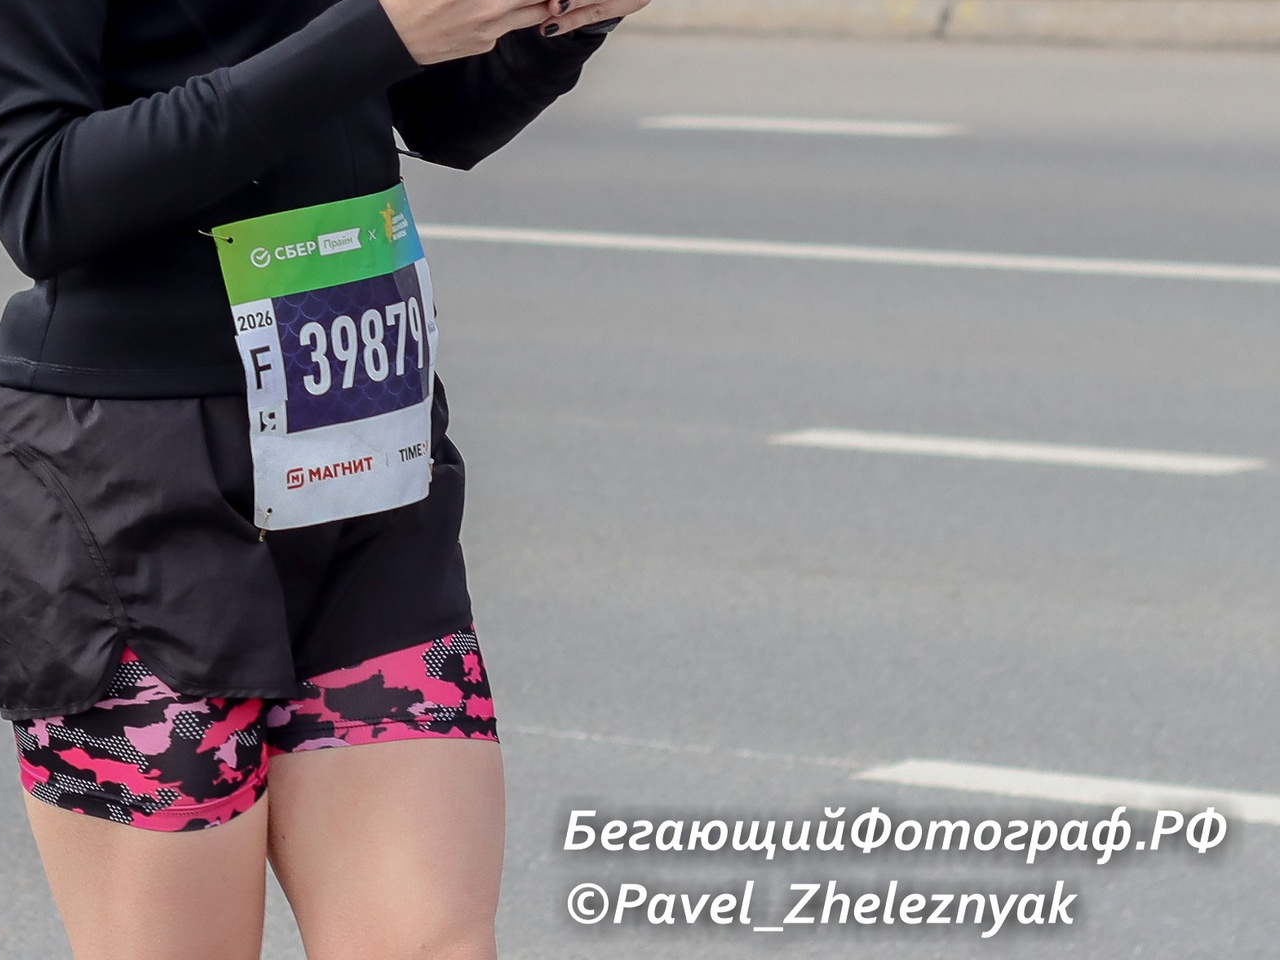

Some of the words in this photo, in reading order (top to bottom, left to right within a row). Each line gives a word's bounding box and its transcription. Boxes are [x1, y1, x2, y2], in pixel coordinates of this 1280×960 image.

[274, 240, 317, 261] СБЕР
[323, 235, 354, 250] Прайм
[237, 311, 273, 331] 2026
[299, 296, 424, 396] 39879
[250, 345, 272, 390] F
[308, 456, 374, 483] МАГНИТ
